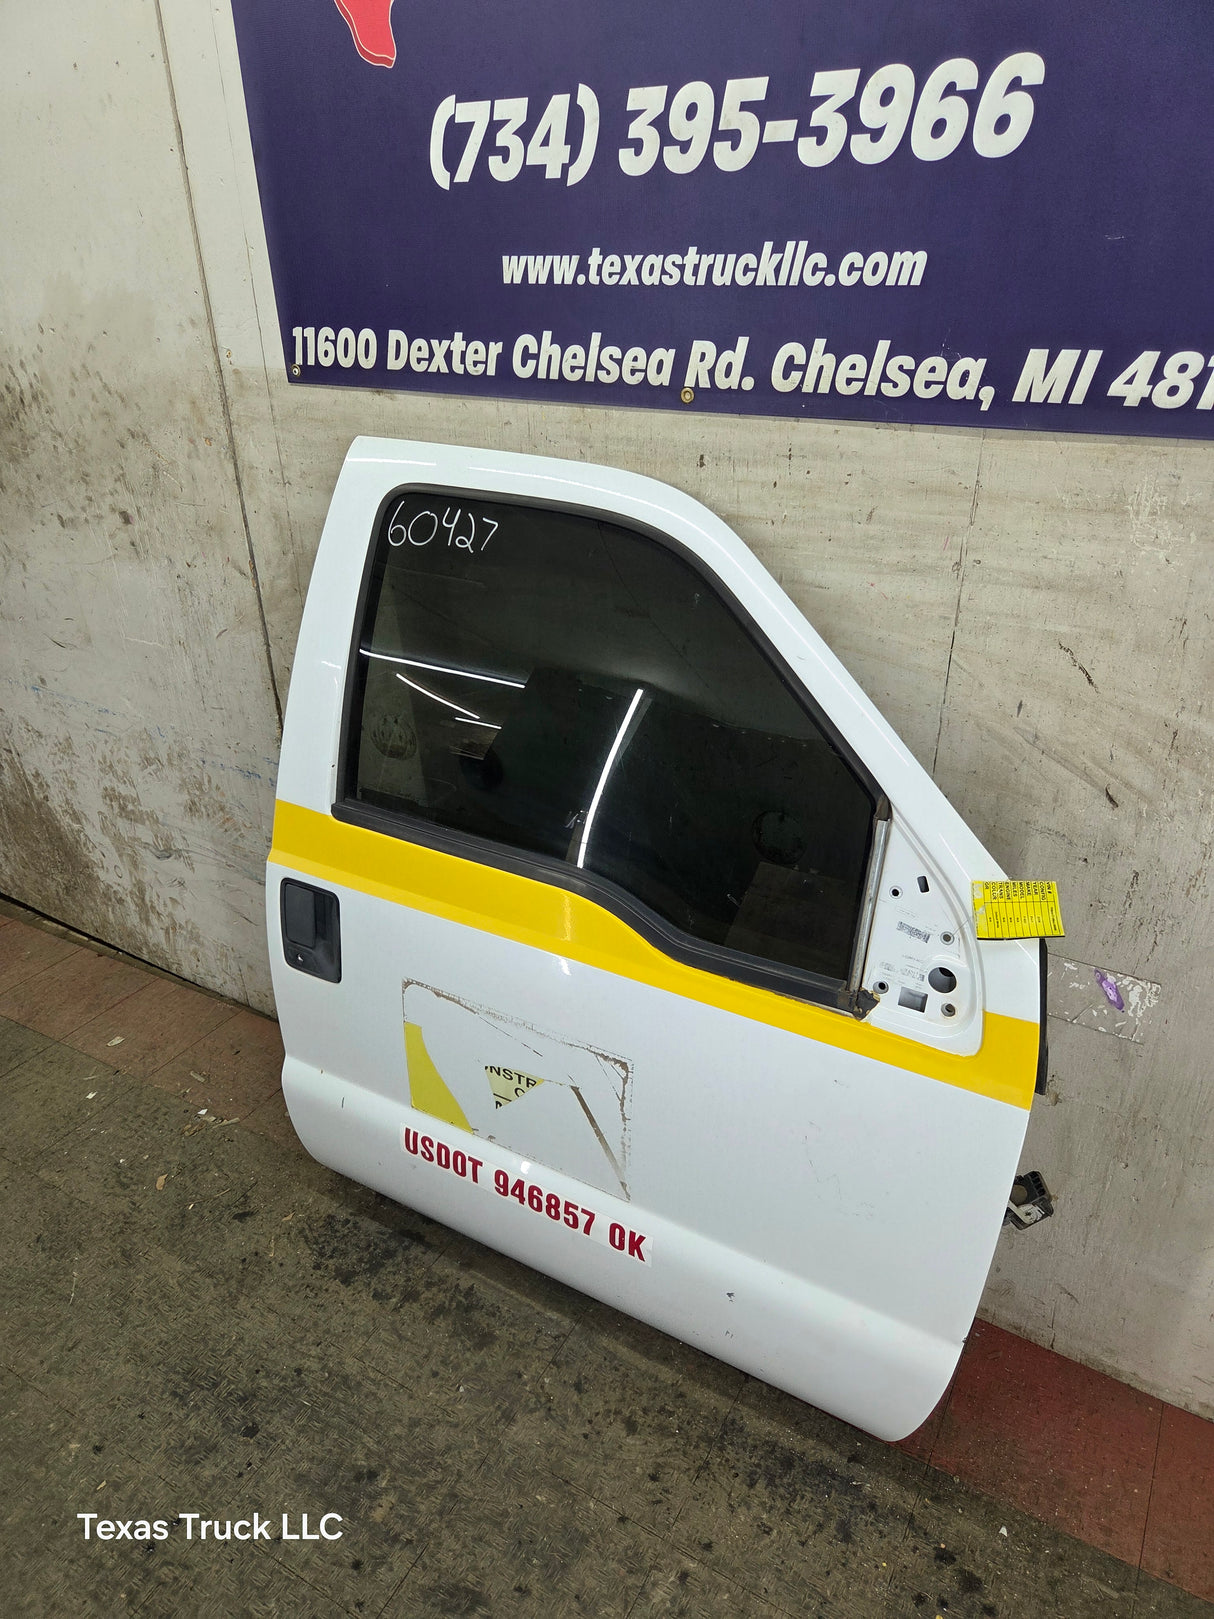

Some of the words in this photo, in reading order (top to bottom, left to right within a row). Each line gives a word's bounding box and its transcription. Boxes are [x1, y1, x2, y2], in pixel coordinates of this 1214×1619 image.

[430, 83, 600, 190] (734)
[618, 51, 1045, 177] 395-3966
[502, 240, 928, 286] www.texastruckllc.com
[292, 326, 377, 369] 11600
[386, 329, 502, 376] Dexter
[512, 330, 676, 386] Chelsea
[683, 336, 755, 390] Rd.
[771, 338, 995, 411] Chelsea,
[1011, 349, 1103, 404] MI
[388, 501, 499, 553] 60427
[484, 1065, 537, 1088] NSTR
[404, 1127, 483, 1184] USDOT
[494, 1169, 596, 1236] 946857
[608, 1222, 647, 1262] OK
